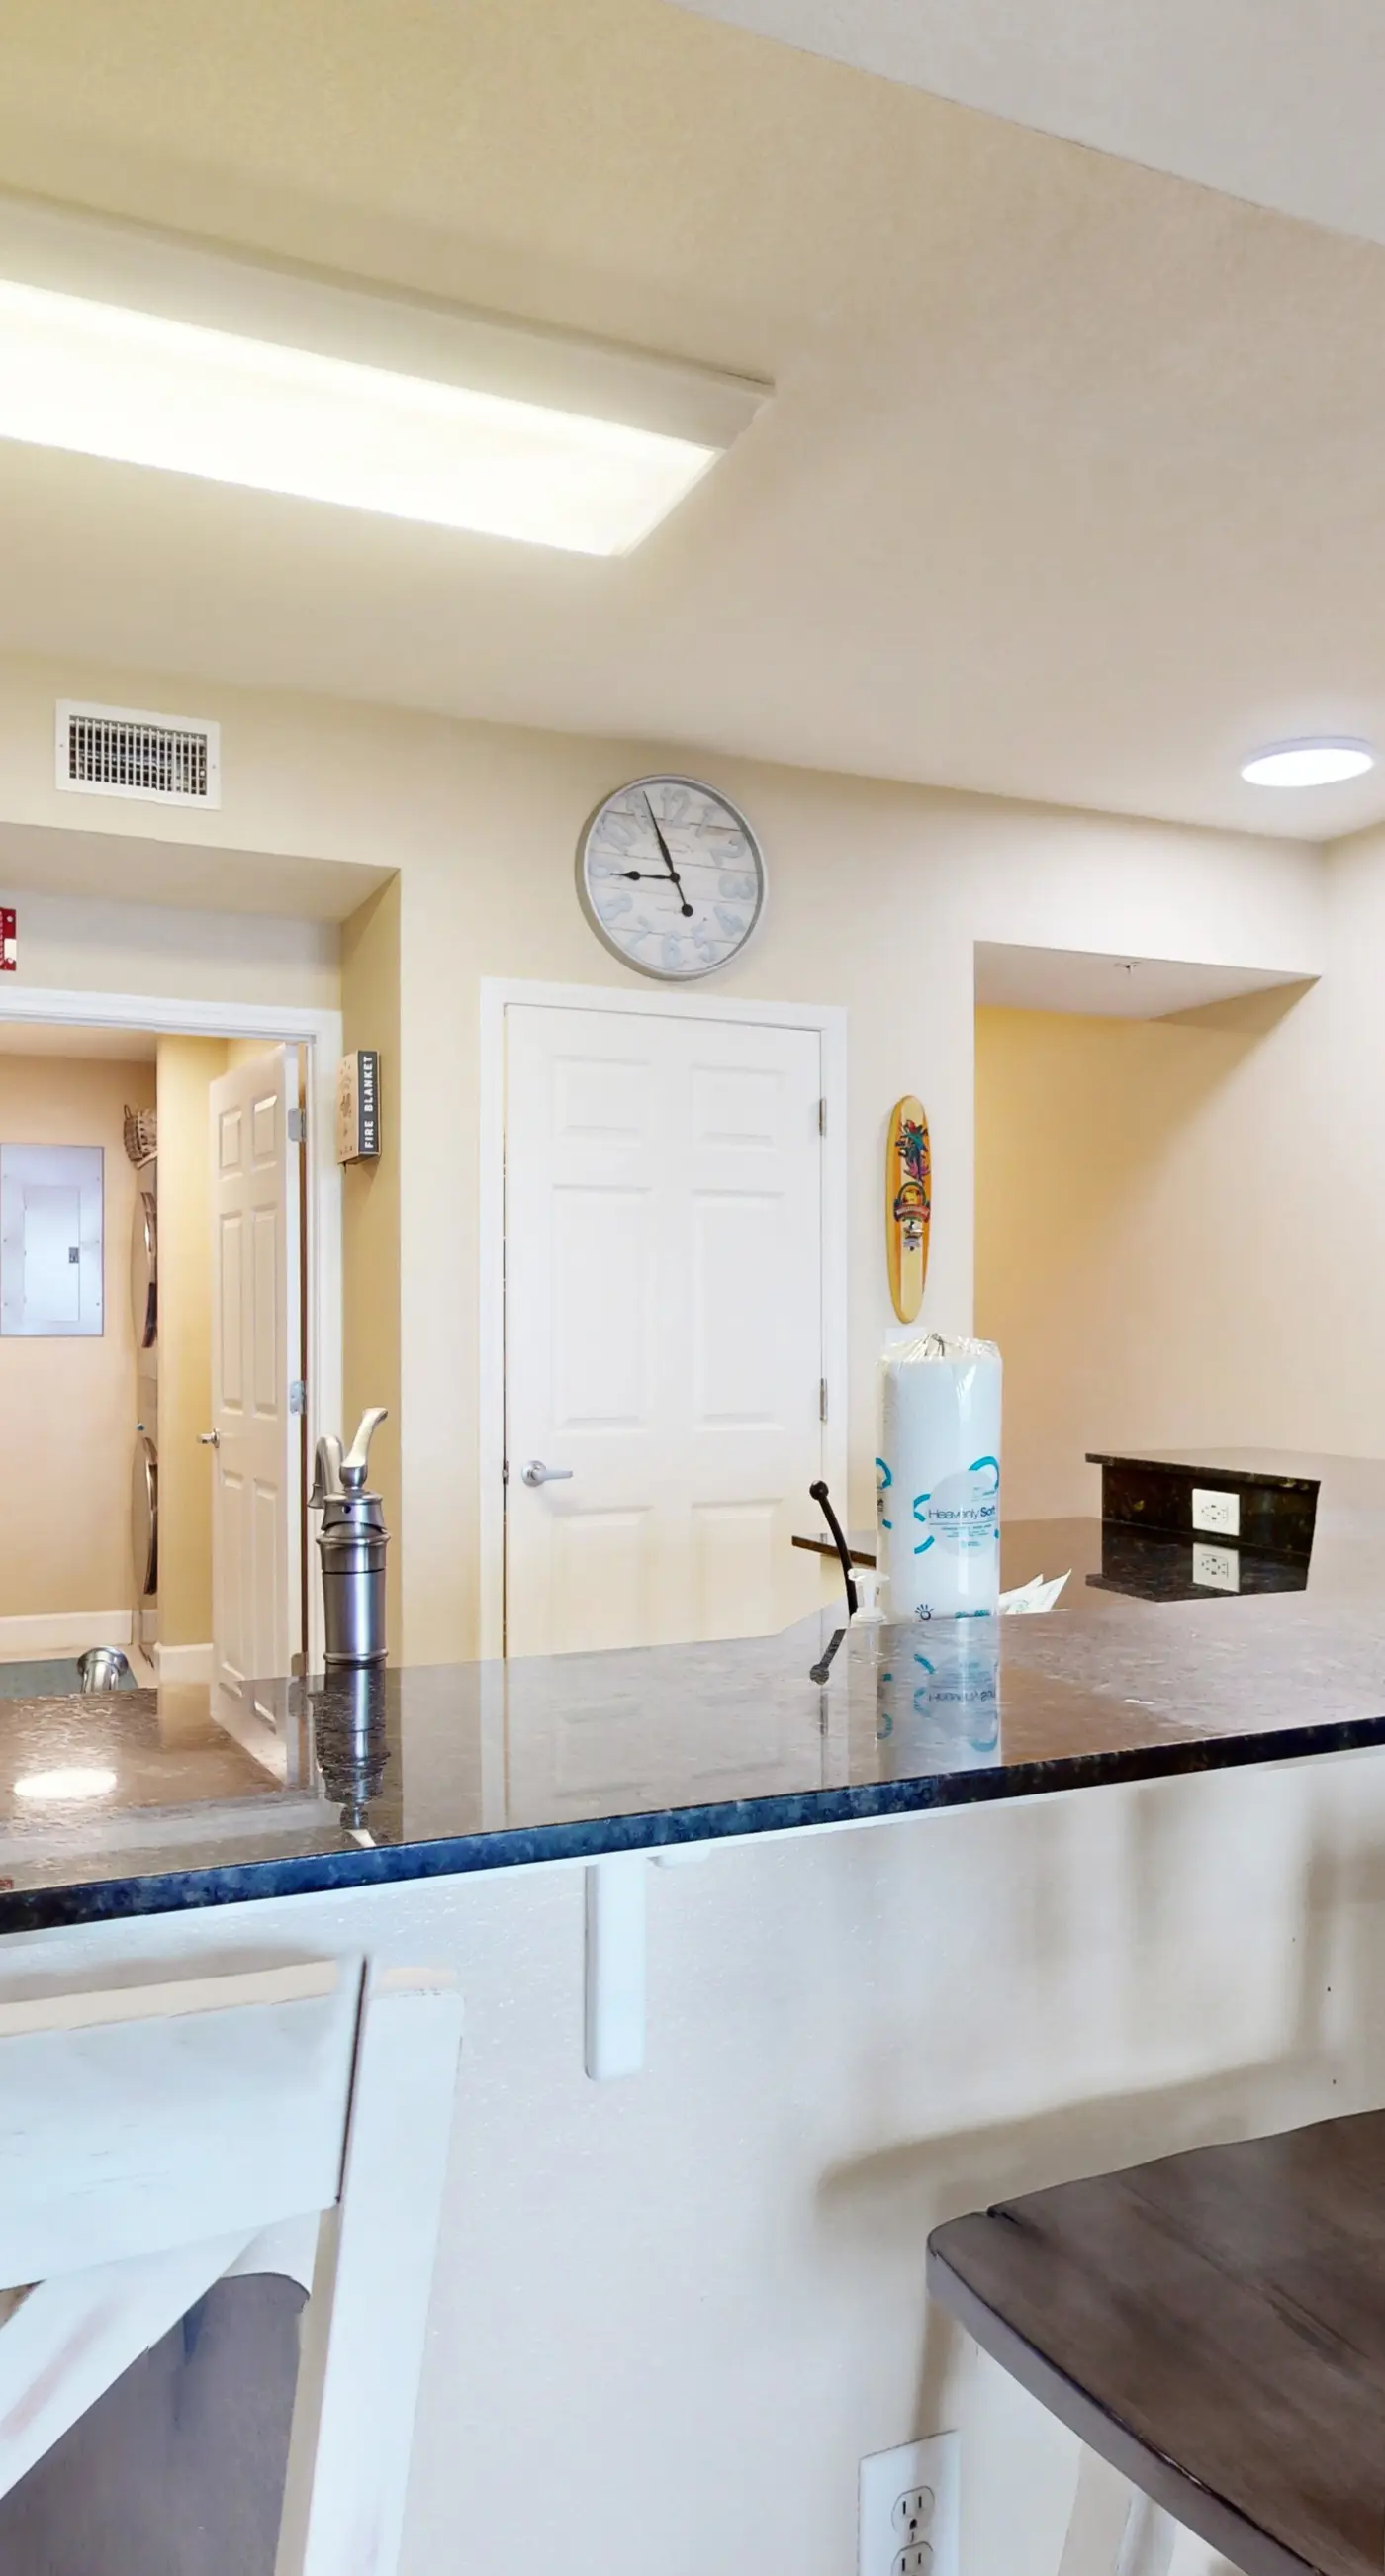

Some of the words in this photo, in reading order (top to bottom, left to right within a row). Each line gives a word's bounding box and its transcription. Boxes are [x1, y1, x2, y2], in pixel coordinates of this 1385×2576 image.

[661, 786, 692, 828] 12
[695, 806, 715, 838] 1
[708, 834, 747, 867] 2
[718, 874, 756, 900] 3
[625, 915, 650, 951] 7
[713, 905, 747, 936] 4
[662, 930, 682, 969] 6
[691, 920, 716, 963] 5
[363, 1056, 374, 1112] BLANKET
[364, 1120, 374, 1149] FIRE
